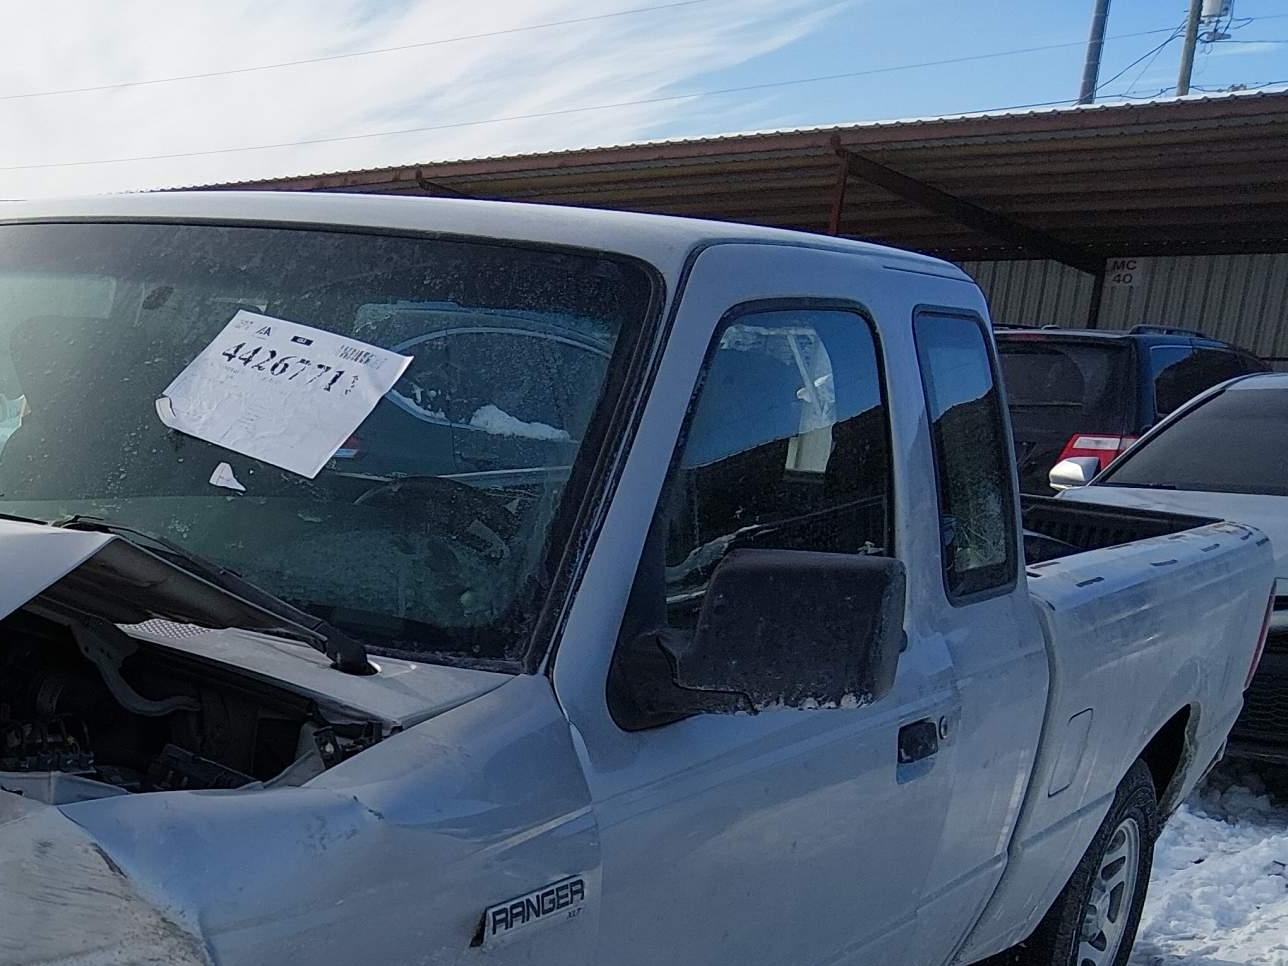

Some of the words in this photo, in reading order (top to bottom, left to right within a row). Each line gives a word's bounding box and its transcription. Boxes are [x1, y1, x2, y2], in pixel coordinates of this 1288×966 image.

[1113, 260, 1137, 271] MC
[1111, 273, 1133, 285] 40
[492, 879, 585, 935] RANGER
